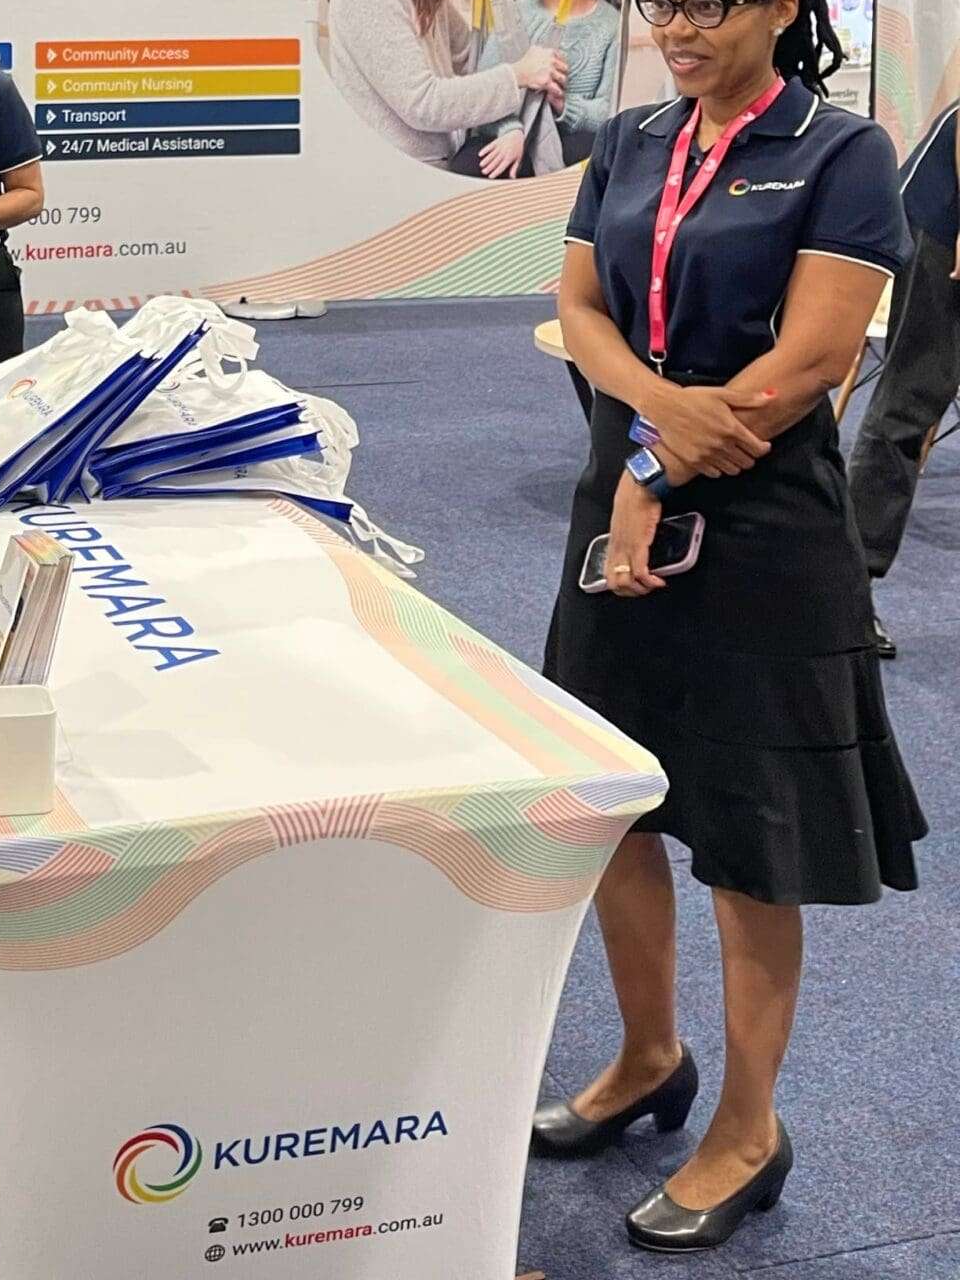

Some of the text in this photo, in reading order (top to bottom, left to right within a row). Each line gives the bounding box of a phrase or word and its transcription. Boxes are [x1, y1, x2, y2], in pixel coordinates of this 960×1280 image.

[62, 46, 189, 63] Community Access
[62, 76, 193, 94] Community Nursing
[62, 109, 127, 124] Transport
[62, 136, 225, 154] 24/7 Medical Assistance
[67, 206, 102, 224] 799
[213, 1110, 449, 1170] KUREMARA
[238, 1196, 364, 1228] 1300 000 799
[232, 1213, 444, 1256] www.kuremara.com.au
